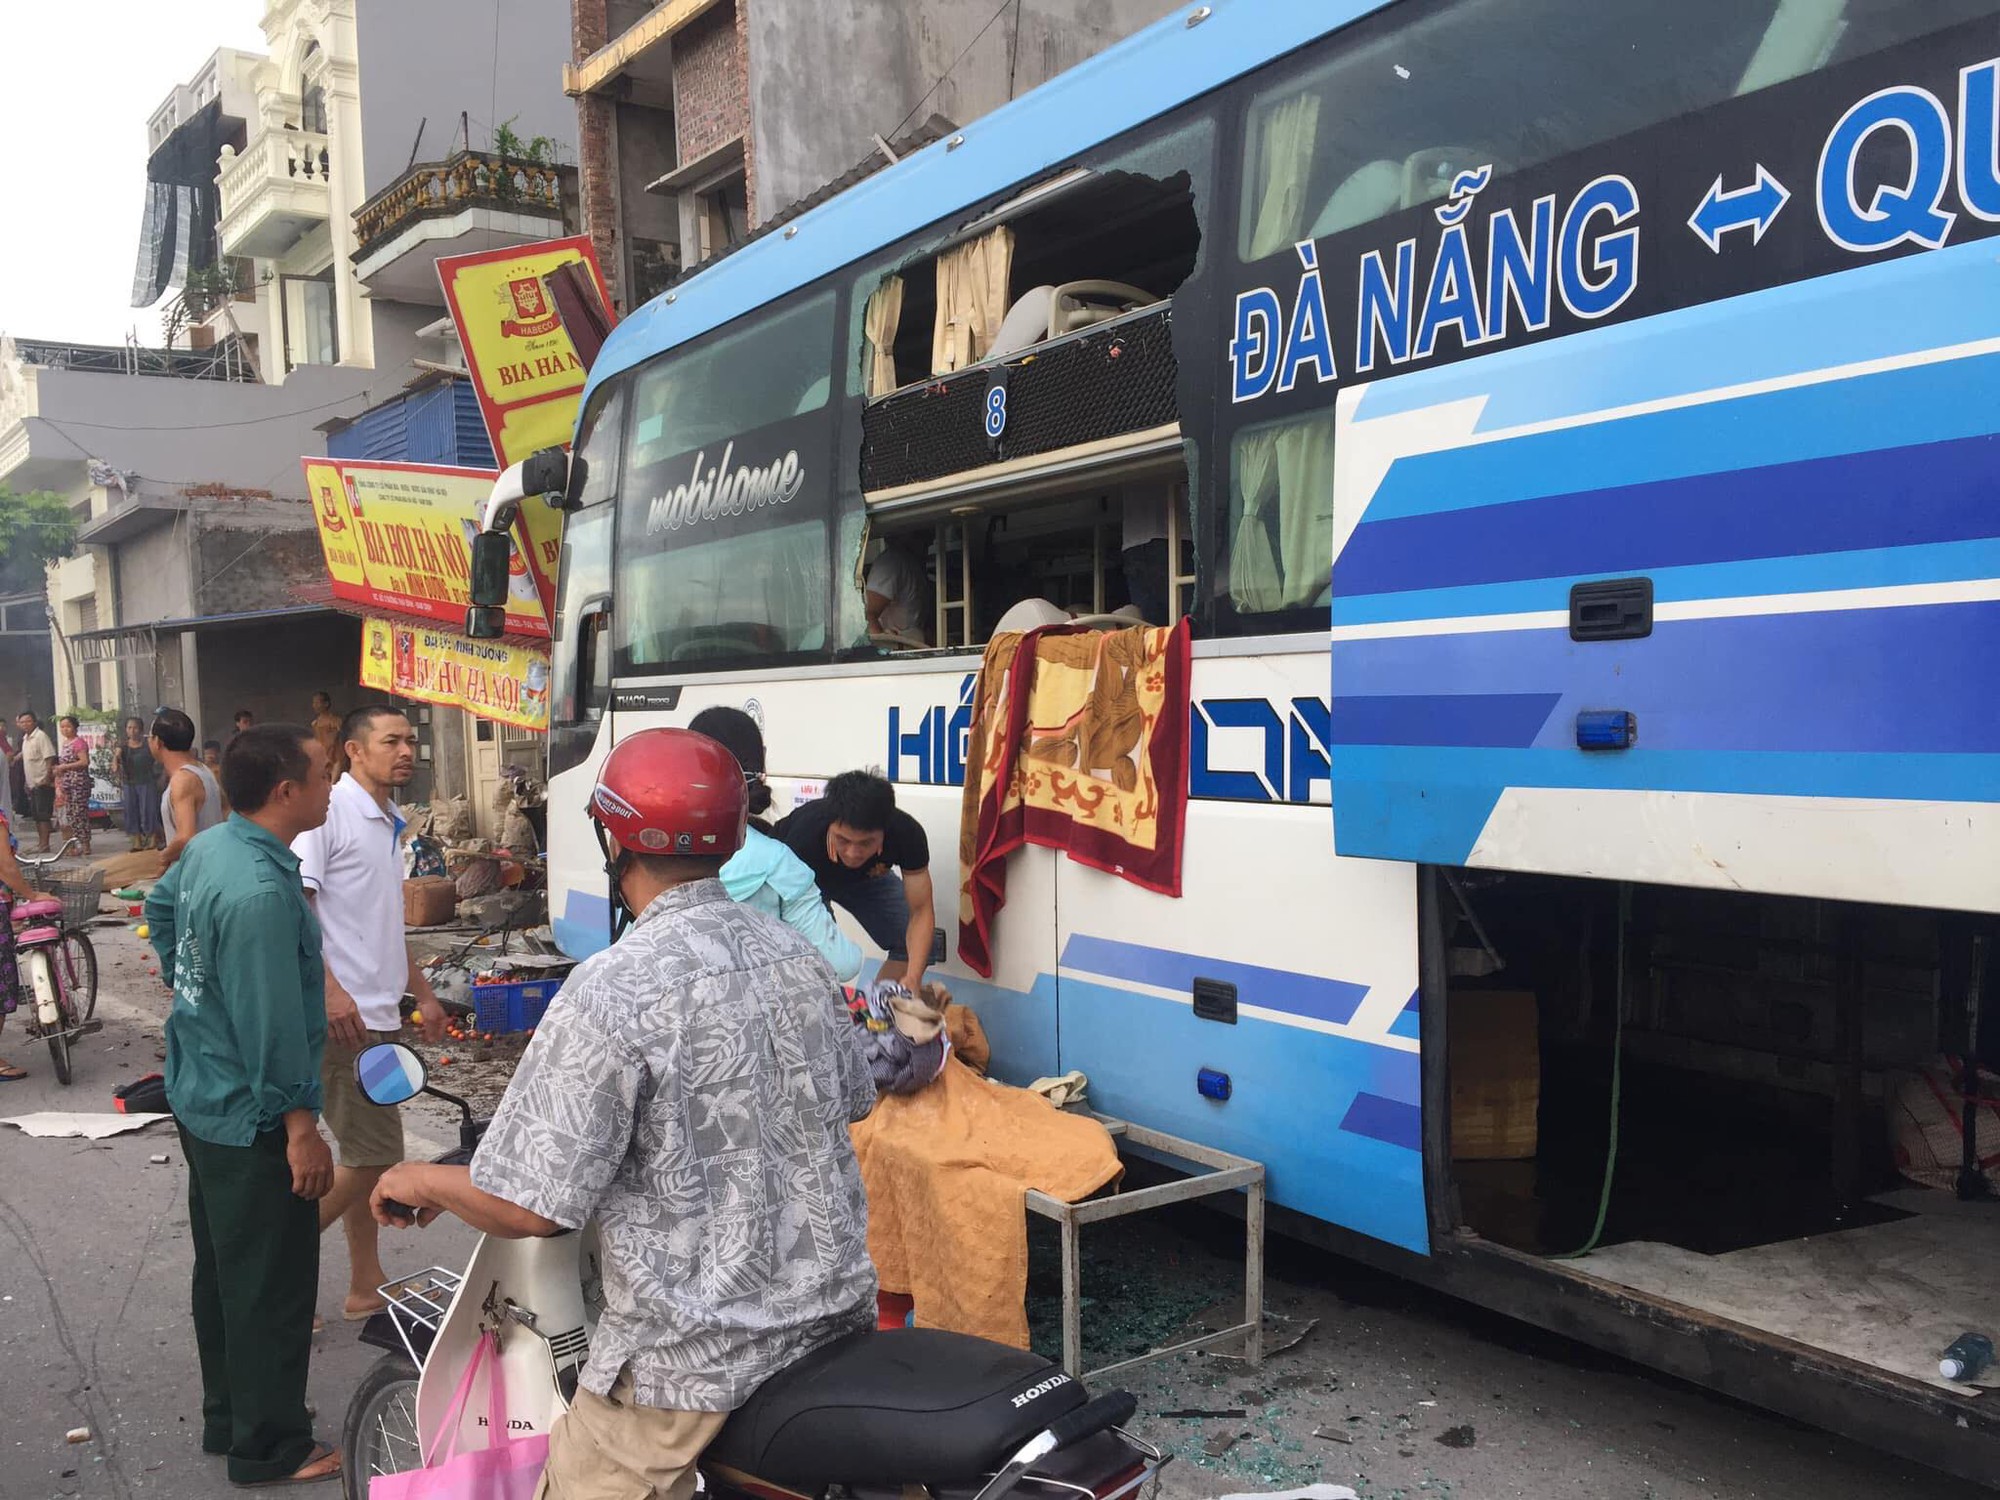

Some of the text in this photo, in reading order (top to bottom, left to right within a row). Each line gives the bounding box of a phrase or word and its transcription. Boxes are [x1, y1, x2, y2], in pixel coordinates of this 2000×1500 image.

[1229, 239, 1337, 403] ĐÀ
[1355, 164, 1640, 373] NẴNG
[520, 321, 554, 335] HABECO
[498, 361, 535, 386] BIA
[535, 351, 566, 378] HÀ
[985, 385, 1007, 437] 8
[646, 440, 805, 536] mobihome
[359, 520, 392, 566] BIA
[410, 516, 446, 576] HÀ
[616, 695, 646, 706] THACO
[1010, 1373, 1072, 1409] HONDA
[477, 1416, 535, 1431] HDA
